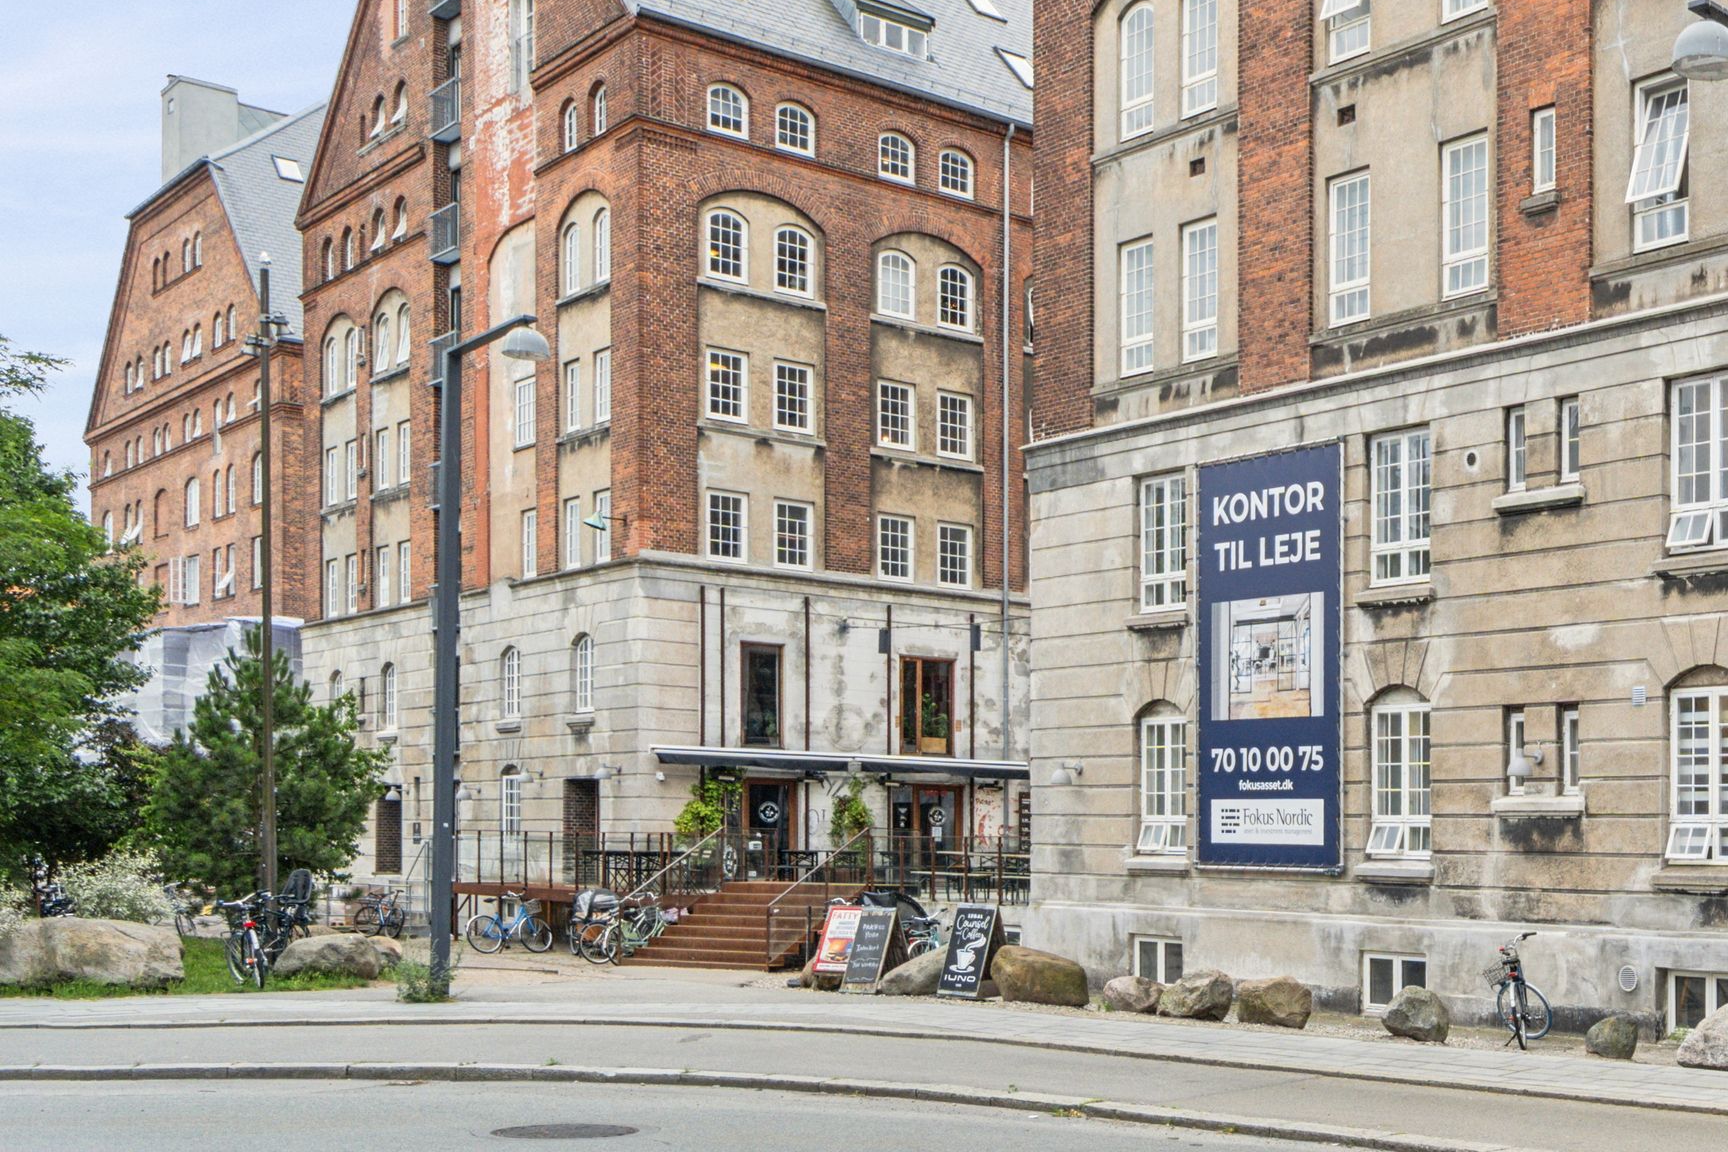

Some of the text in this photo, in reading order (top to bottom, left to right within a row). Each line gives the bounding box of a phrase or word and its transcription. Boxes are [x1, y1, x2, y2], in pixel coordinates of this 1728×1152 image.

[1213, 481, 1325, 526] KONTOR
[1214, 529, 1321, 572] TIL LEJE
[1211, 745, 1324, 773] 70 10 00 75
[1239, 779, 1294, 791] fokusasset.dk
[1243, 808, 1313, 826] Fokus Nordic
[832, 912, 859, 920] FATTY
[956, 914, 991, 930] Counsel
[962, 928, 982, 941] Coffee
[944, 974, 976, 983] IUNO
